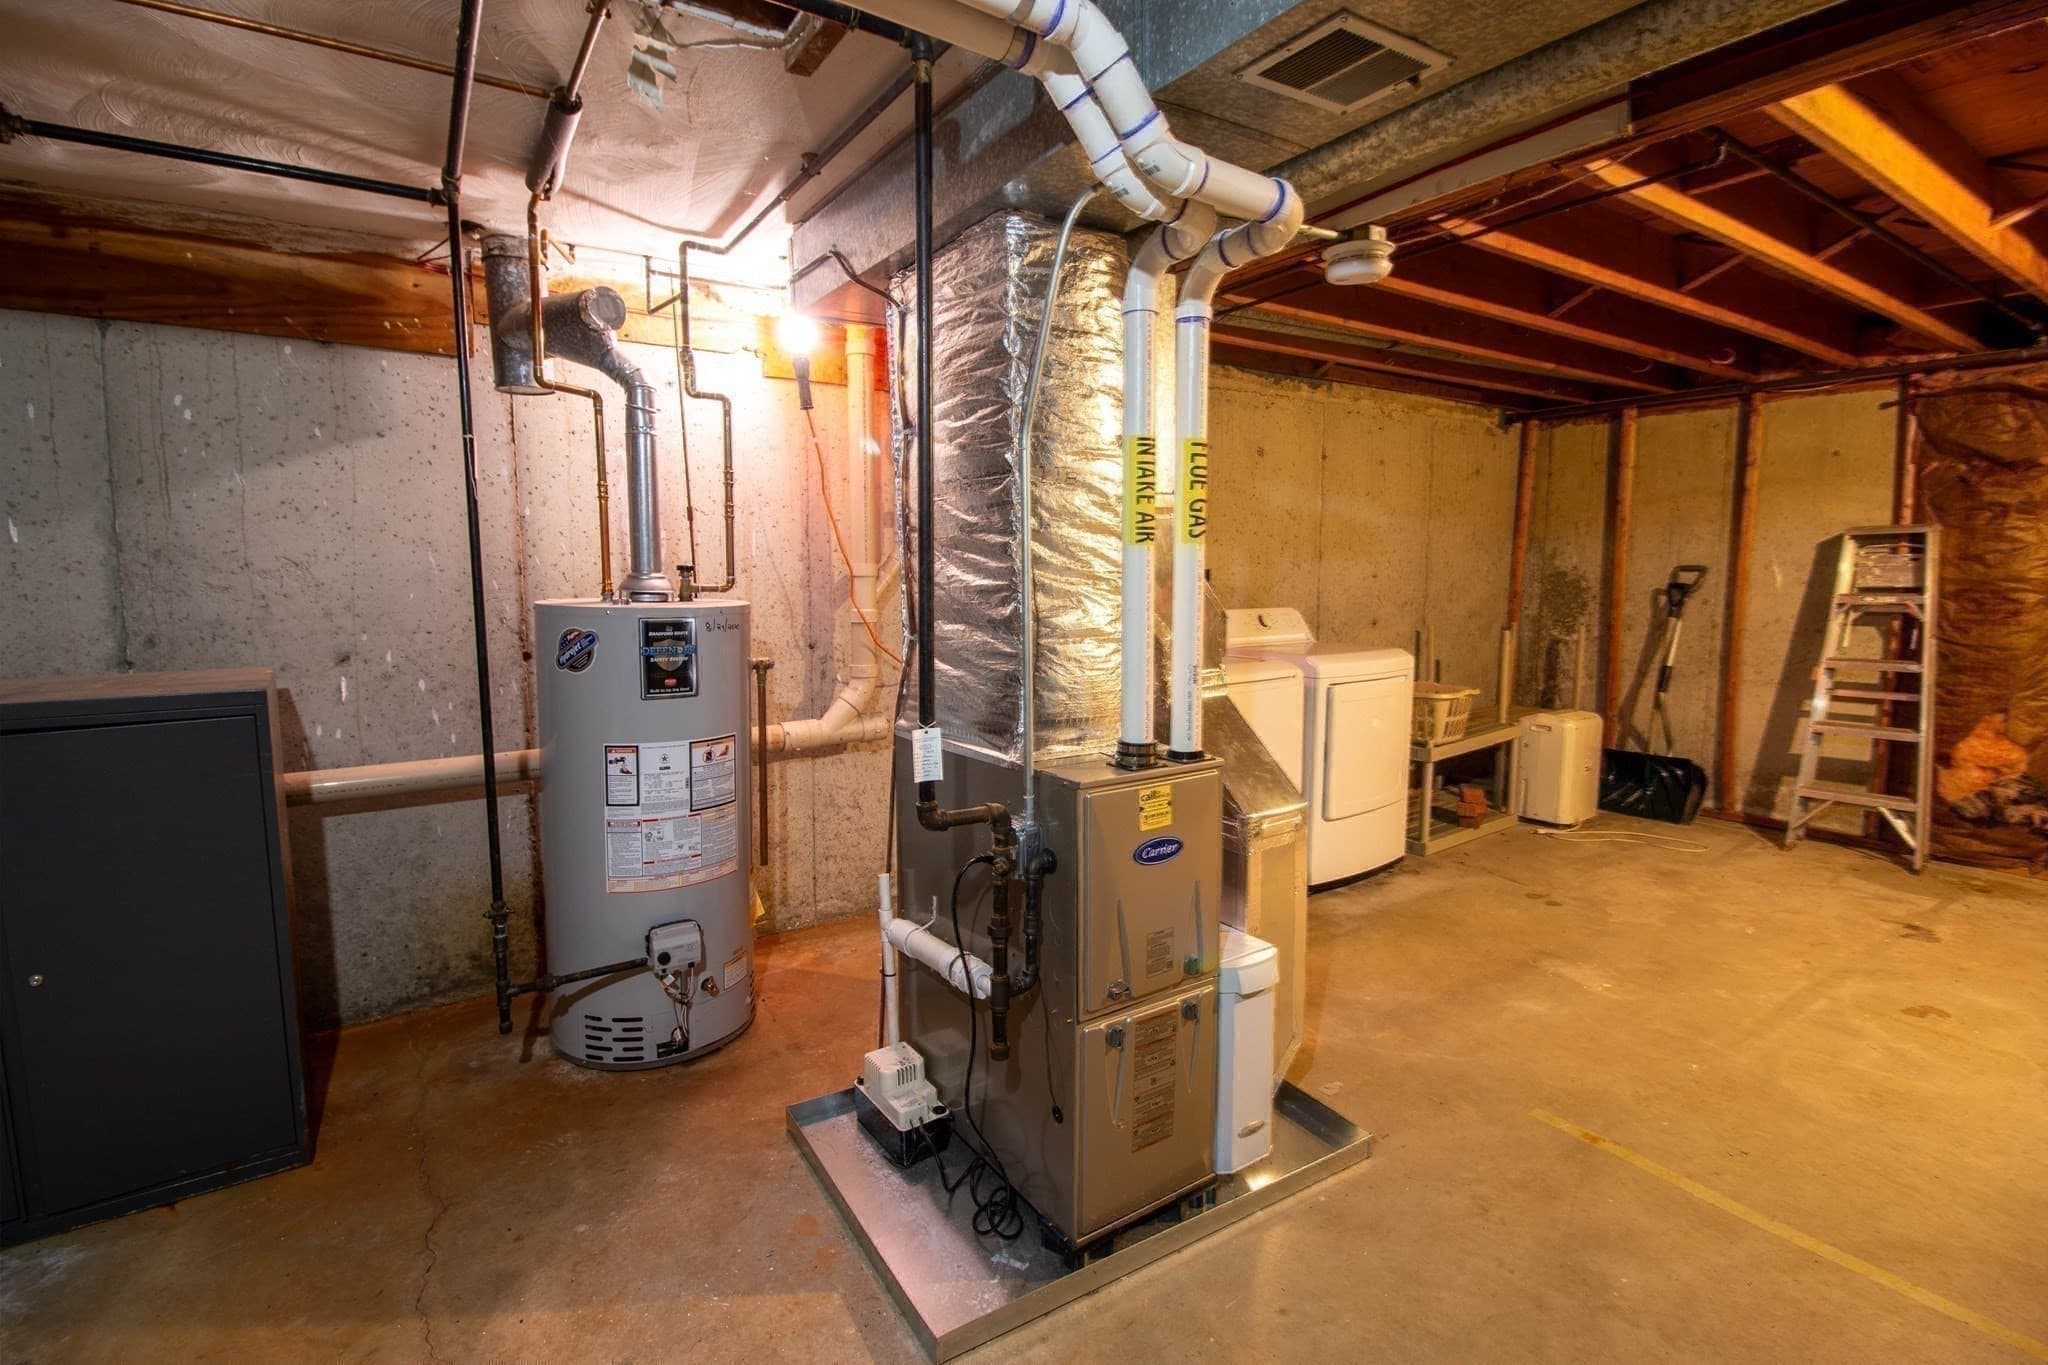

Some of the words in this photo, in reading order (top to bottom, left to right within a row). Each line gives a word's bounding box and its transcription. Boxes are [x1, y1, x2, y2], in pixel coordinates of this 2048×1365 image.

[1135, 511, 1155, 543] AIR
[1188, 498, 1207, 539] GAS
[1142, 843, 1178, 859] Carrier
